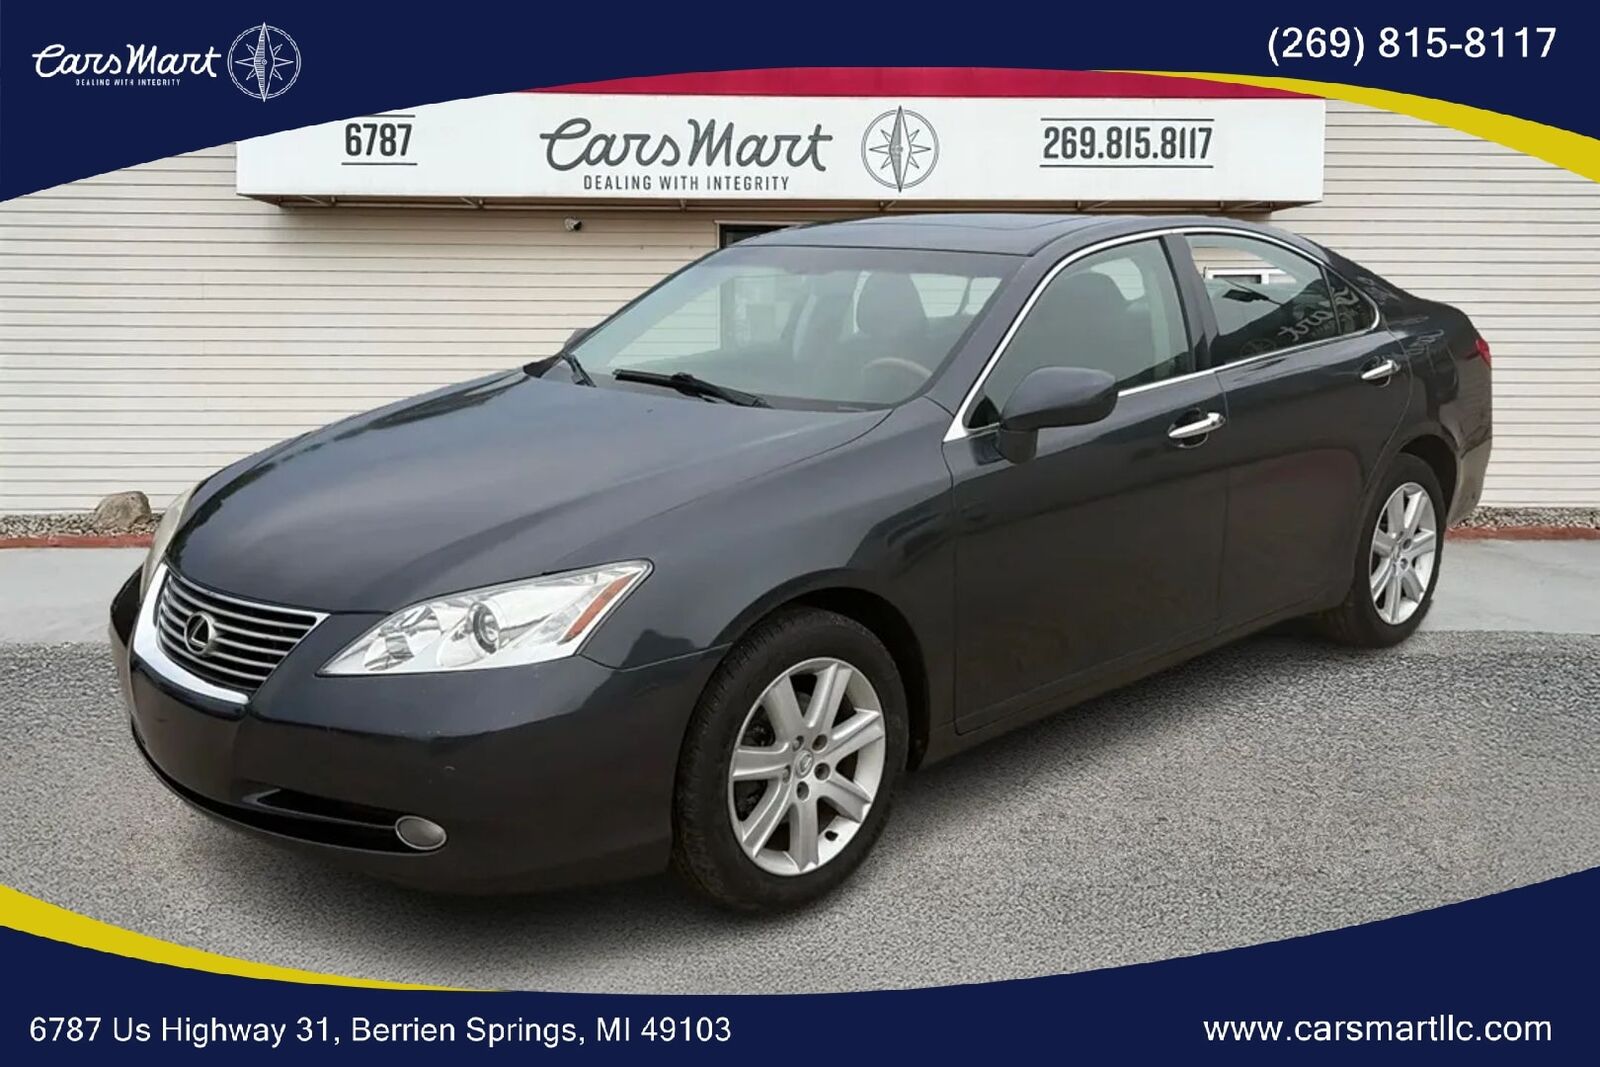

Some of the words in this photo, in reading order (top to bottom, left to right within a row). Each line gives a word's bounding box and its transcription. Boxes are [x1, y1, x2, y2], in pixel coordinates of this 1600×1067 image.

[344, 122, 413, 157] 6787
[1043, 126, 1213, 160] 269.815.8117
[583, 174, 652, 191] DEALING
[659, 175, 698, 190] WITH
[707, 175, 790, 191] INTEGRITY
